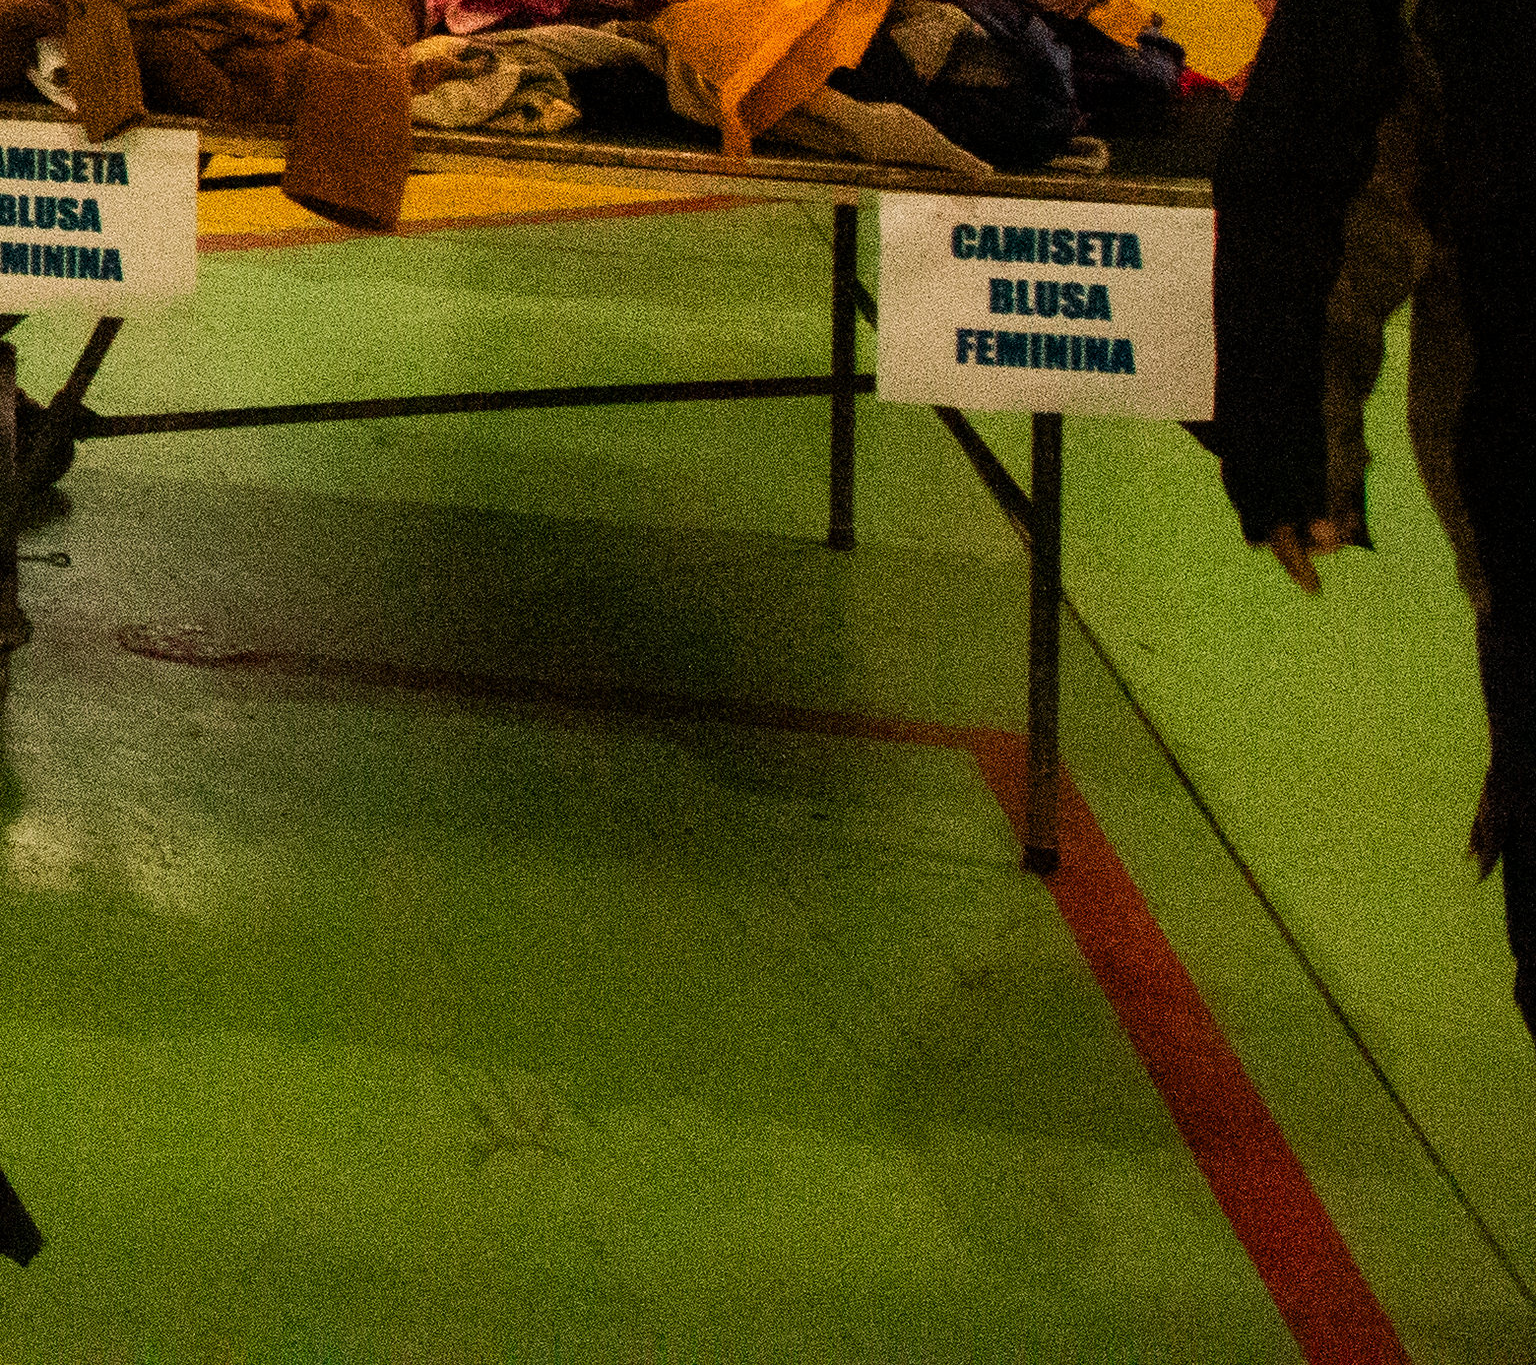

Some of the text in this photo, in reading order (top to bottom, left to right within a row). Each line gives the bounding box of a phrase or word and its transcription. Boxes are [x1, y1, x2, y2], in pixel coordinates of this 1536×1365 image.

[951, 223, 1144, 270] CAMISETA
[989, 277, 1113, 321] BLUSA
[955, 328, 1137, 375] FEMININA
